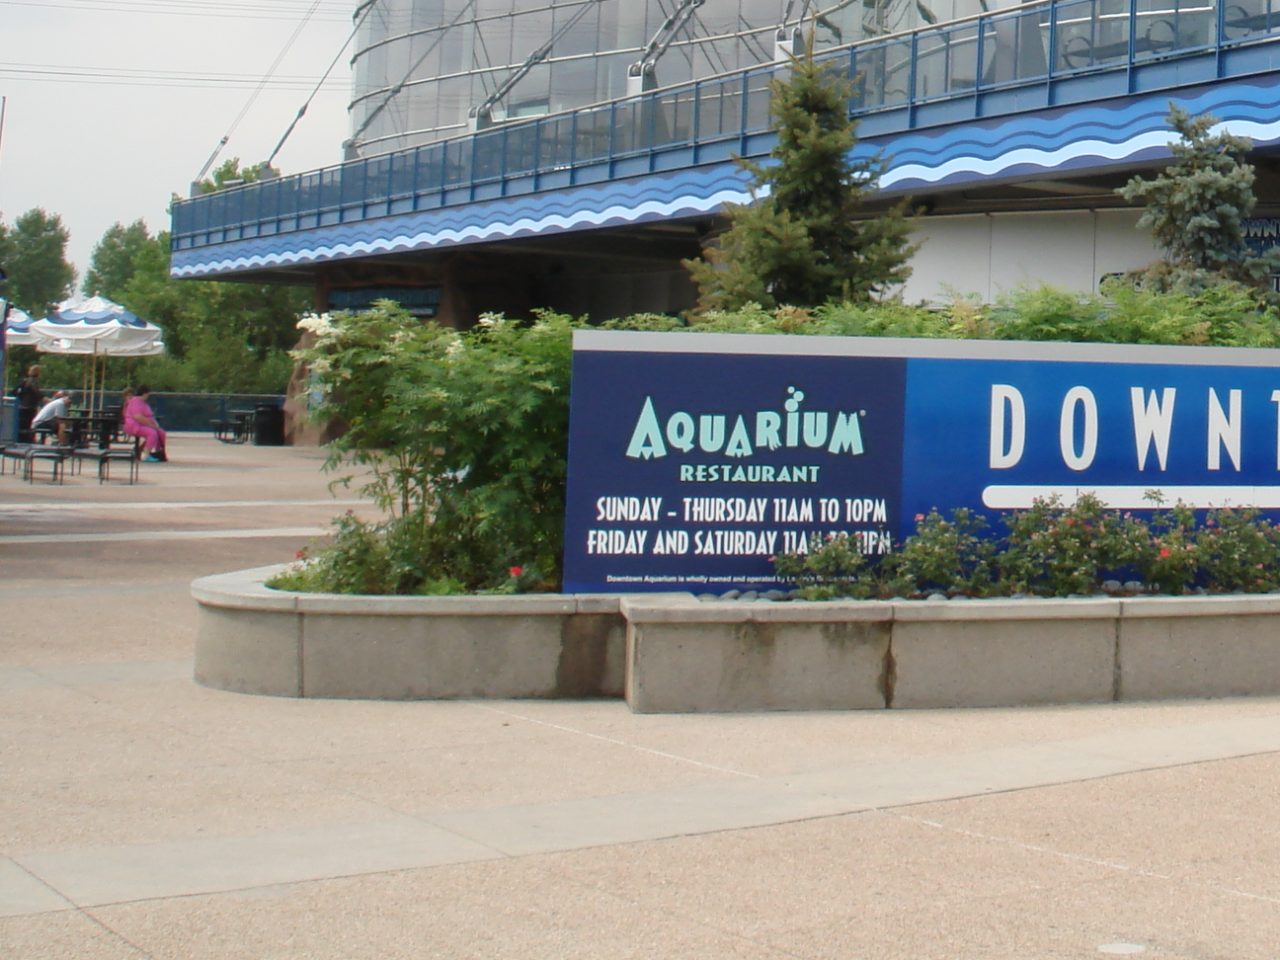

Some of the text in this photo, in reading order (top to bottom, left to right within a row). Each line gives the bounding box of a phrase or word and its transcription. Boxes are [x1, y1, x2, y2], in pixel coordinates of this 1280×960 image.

[626, 386, 864, 460] AQUARIUM
[680, 464, 820, 483] RESTAURANT
[596, 497, 662, 522] SUNDAY
[683, 497, 768, 523] THURSDAY
[773, 498, 814, 523] 11AM
[820, 498, 839, 523] TO
[845, 498, 887, 523] 10PM
[587, 530, 648, 555] FRIDAY
[653, 530, 688, 555] AND
[694, 530, 778, 555] SATURDAY
[607, 574, 643, 583] Downtown
[644, 575, 677, 584] Aquarium
[732, 575, 746, 583] and
